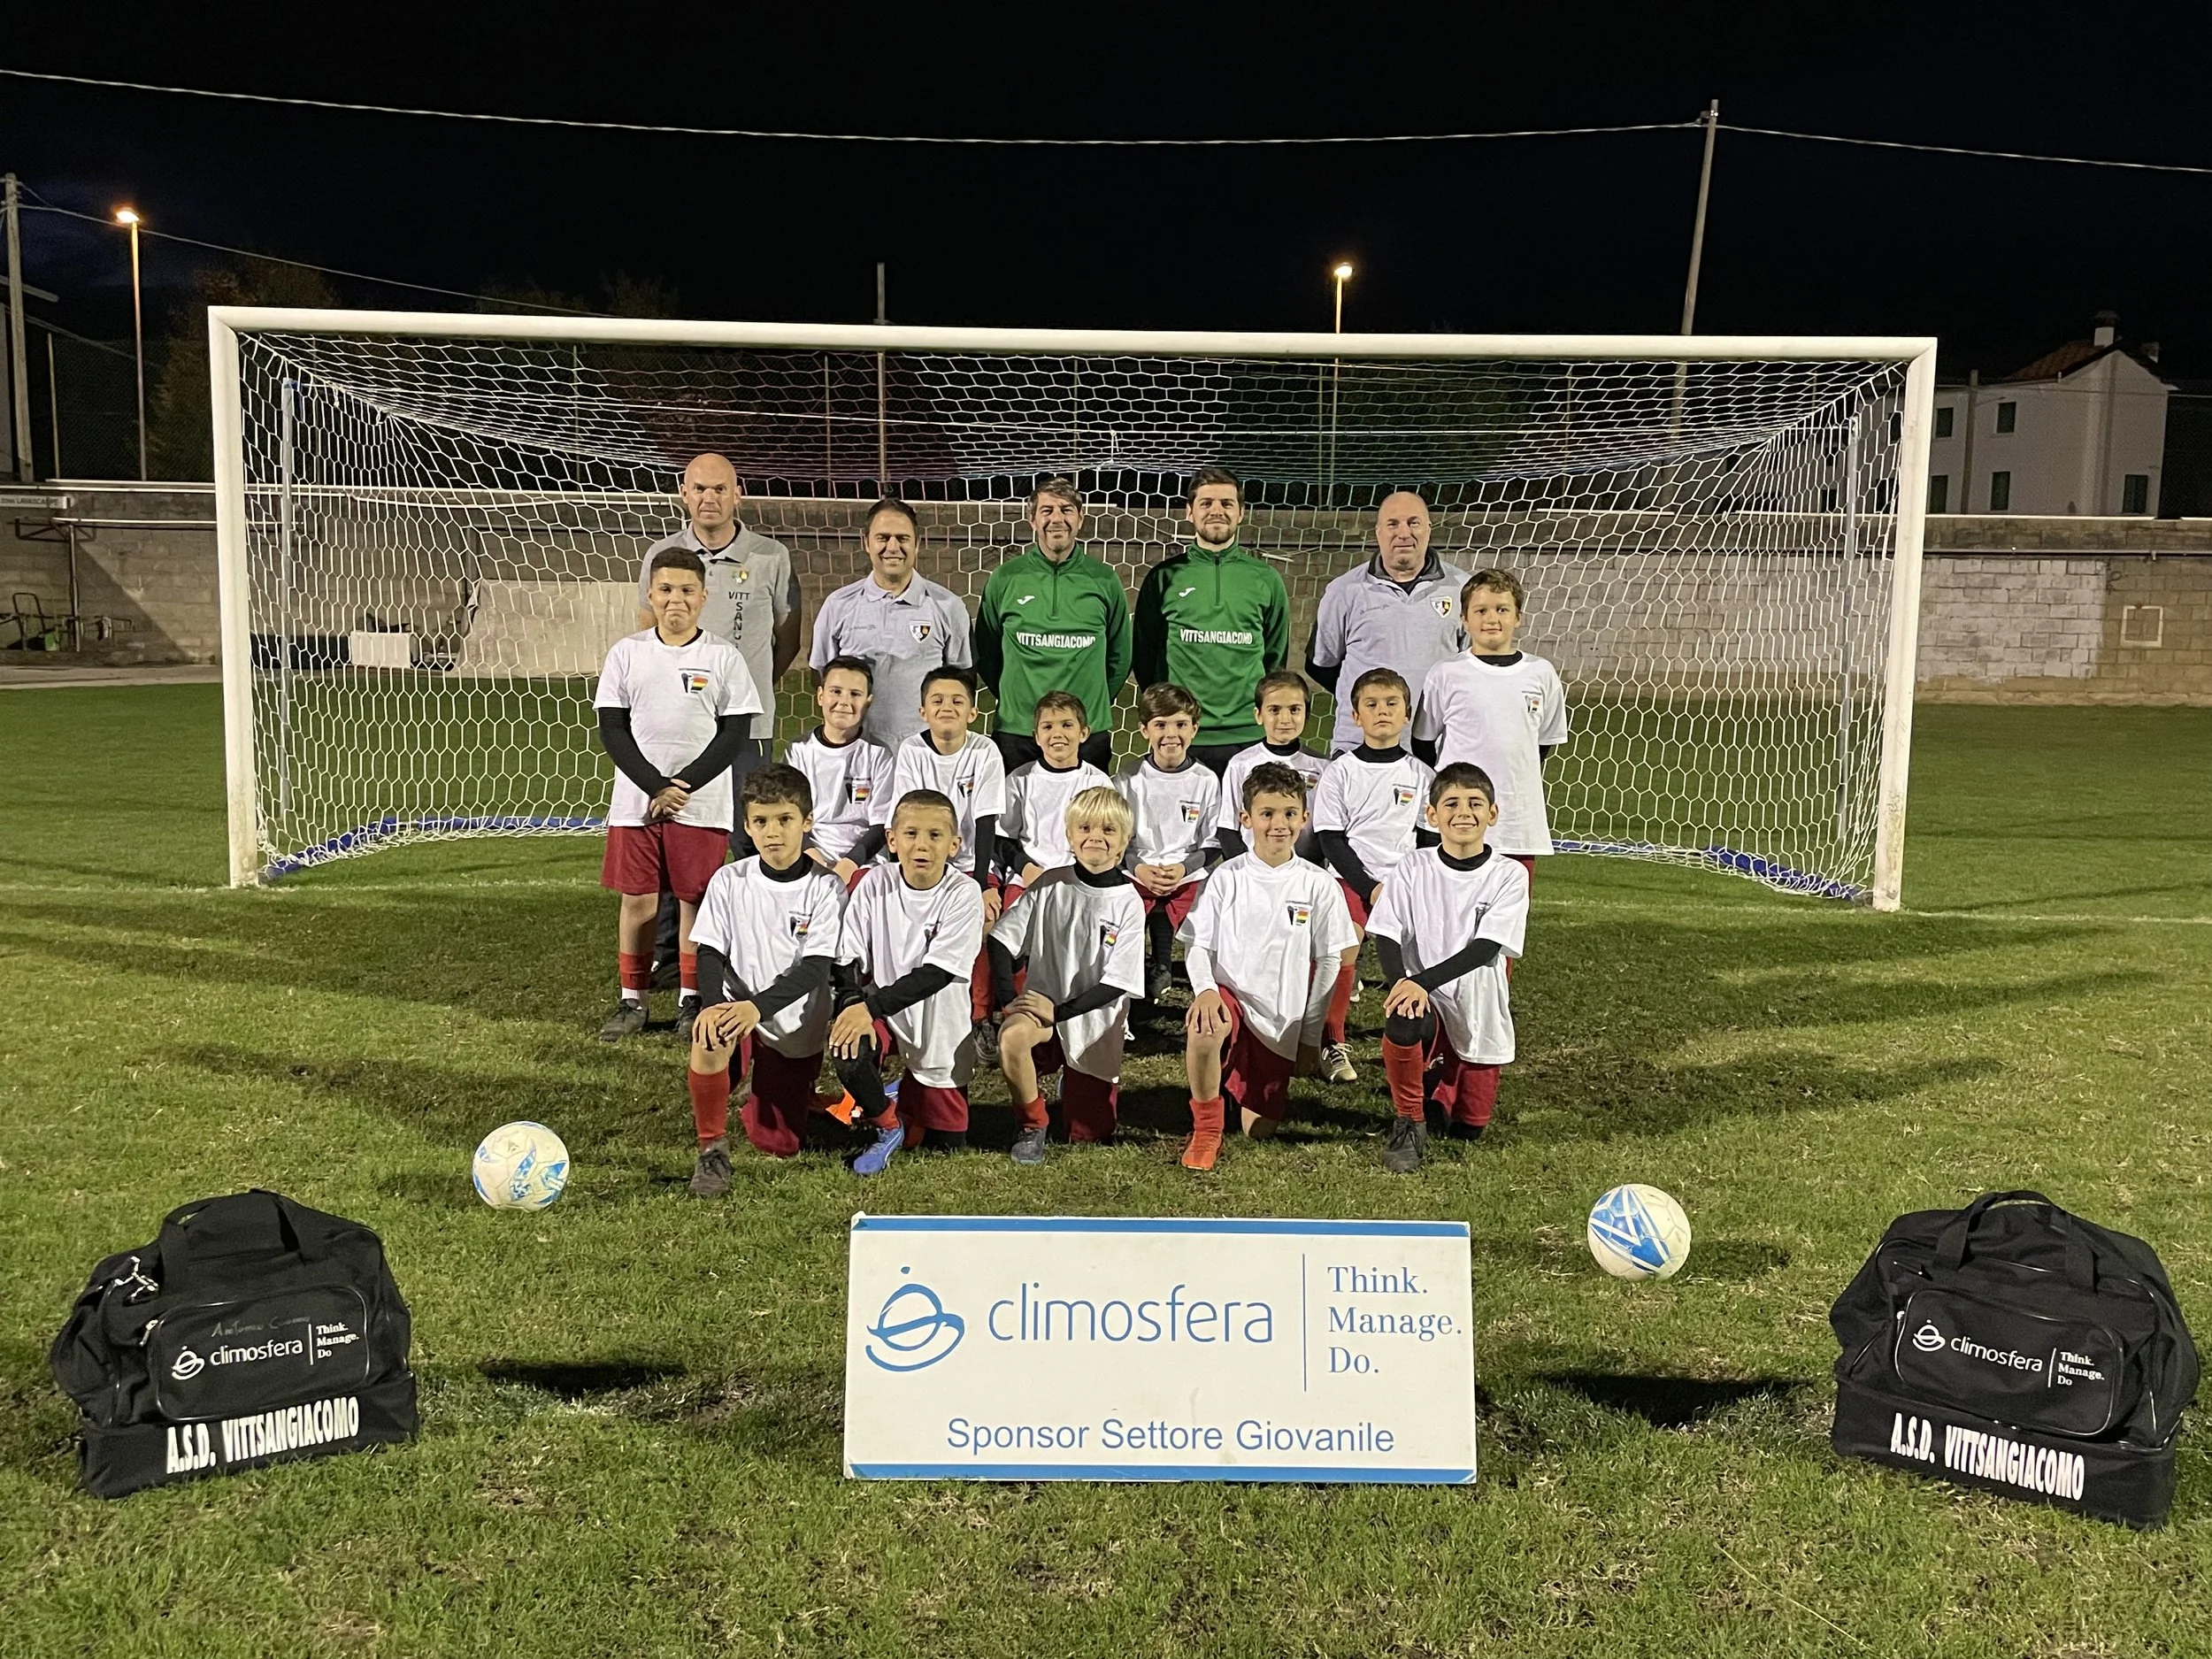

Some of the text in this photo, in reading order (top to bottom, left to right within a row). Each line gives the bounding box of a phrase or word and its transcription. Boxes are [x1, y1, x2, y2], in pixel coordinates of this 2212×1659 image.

[728, 591, 750, 601] VITT
[1180, 628, 1253, 645] VITTSANGIACOMO
[1327, 1265, 1428, 1294] Think.
[988, 1282, 1272, 1343] climosfera
[1327, 1306, 1462, 1342] Manage.
[316, 1322, 349, 1336] Think.
[317, 1333, 360, 1347] Manage.
[210, 1339, 303, 1366] climosfera
[1328, 1346, 1379, 1374] Do.
[1950, 1335, 2043, 1372] climosfera
[2059, 1351, 2095, 1366] Think.
[2058, 1363, 2105, 1380] Manage.
[166, 1396, 359, 1474] A.S.D. VITTSANGIACOMO
[947, 1417, 1395, 1456] Sponsor Settore Giovanile
[1890, 1412, 2085, 1501] A.S.D. VITTSANGIACOMO
